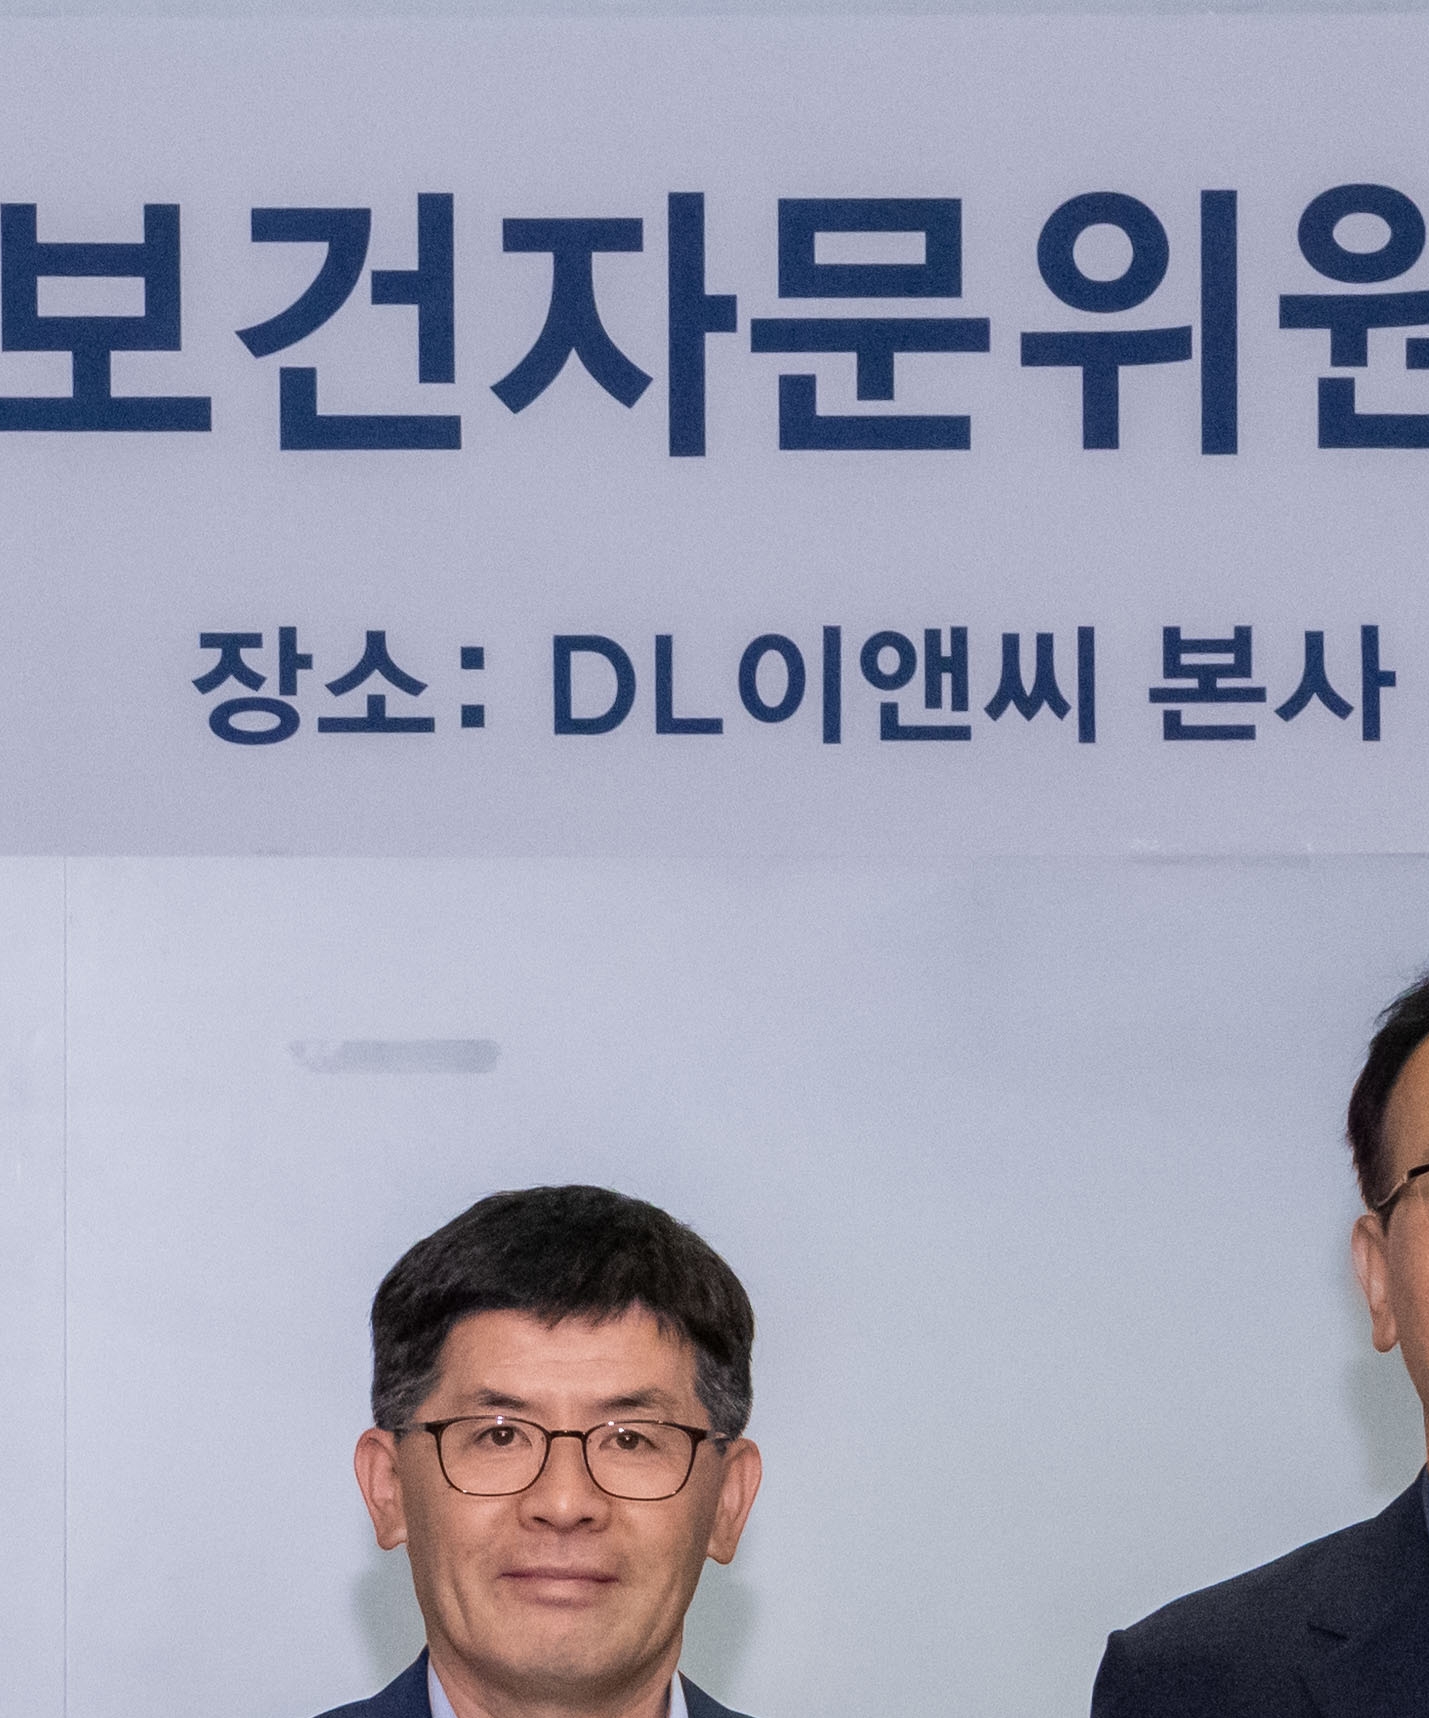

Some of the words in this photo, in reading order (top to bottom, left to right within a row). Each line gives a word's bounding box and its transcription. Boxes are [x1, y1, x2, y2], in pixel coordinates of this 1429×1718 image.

[193, 627, 485, 745] 장소:
[553, 626, 1095, 744] DL이앤씨
[1149, 625, 1396, 741] 본사
